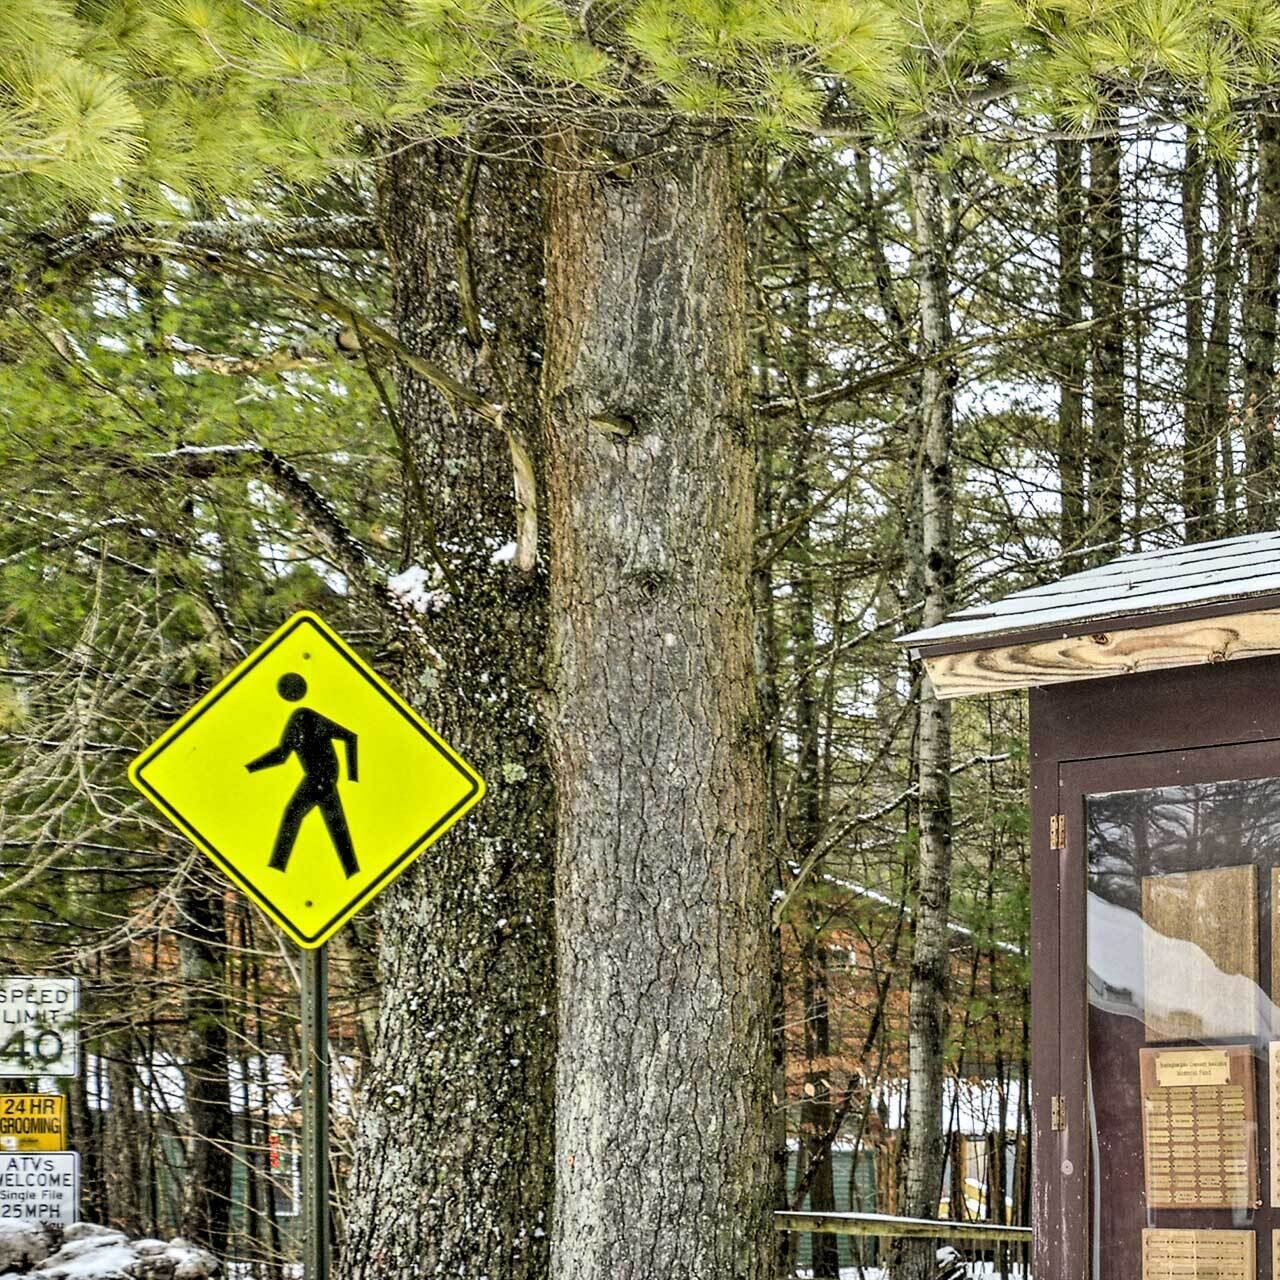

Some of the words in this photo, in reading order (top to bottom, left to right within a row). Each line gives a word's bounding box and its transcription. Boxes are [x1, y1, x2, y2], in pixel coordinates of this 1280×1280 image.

[0, 989, 68, 1004] SPEED
[3, 1009, 60, 1024] LIMIT
[0, 1030, 64, 1065] 40
[4, 1098, 26, 1115] 24
[29, 1098, 56, 1115] HR
[0, 1117, 61, 1134] GROOMING
[6, 1157, 55, 1172] ATVs
[0, 1173, 73, 1187] ELCOME
[0, 1190, 36, 1202] Single
[41, 1190, 63, 1200] File
